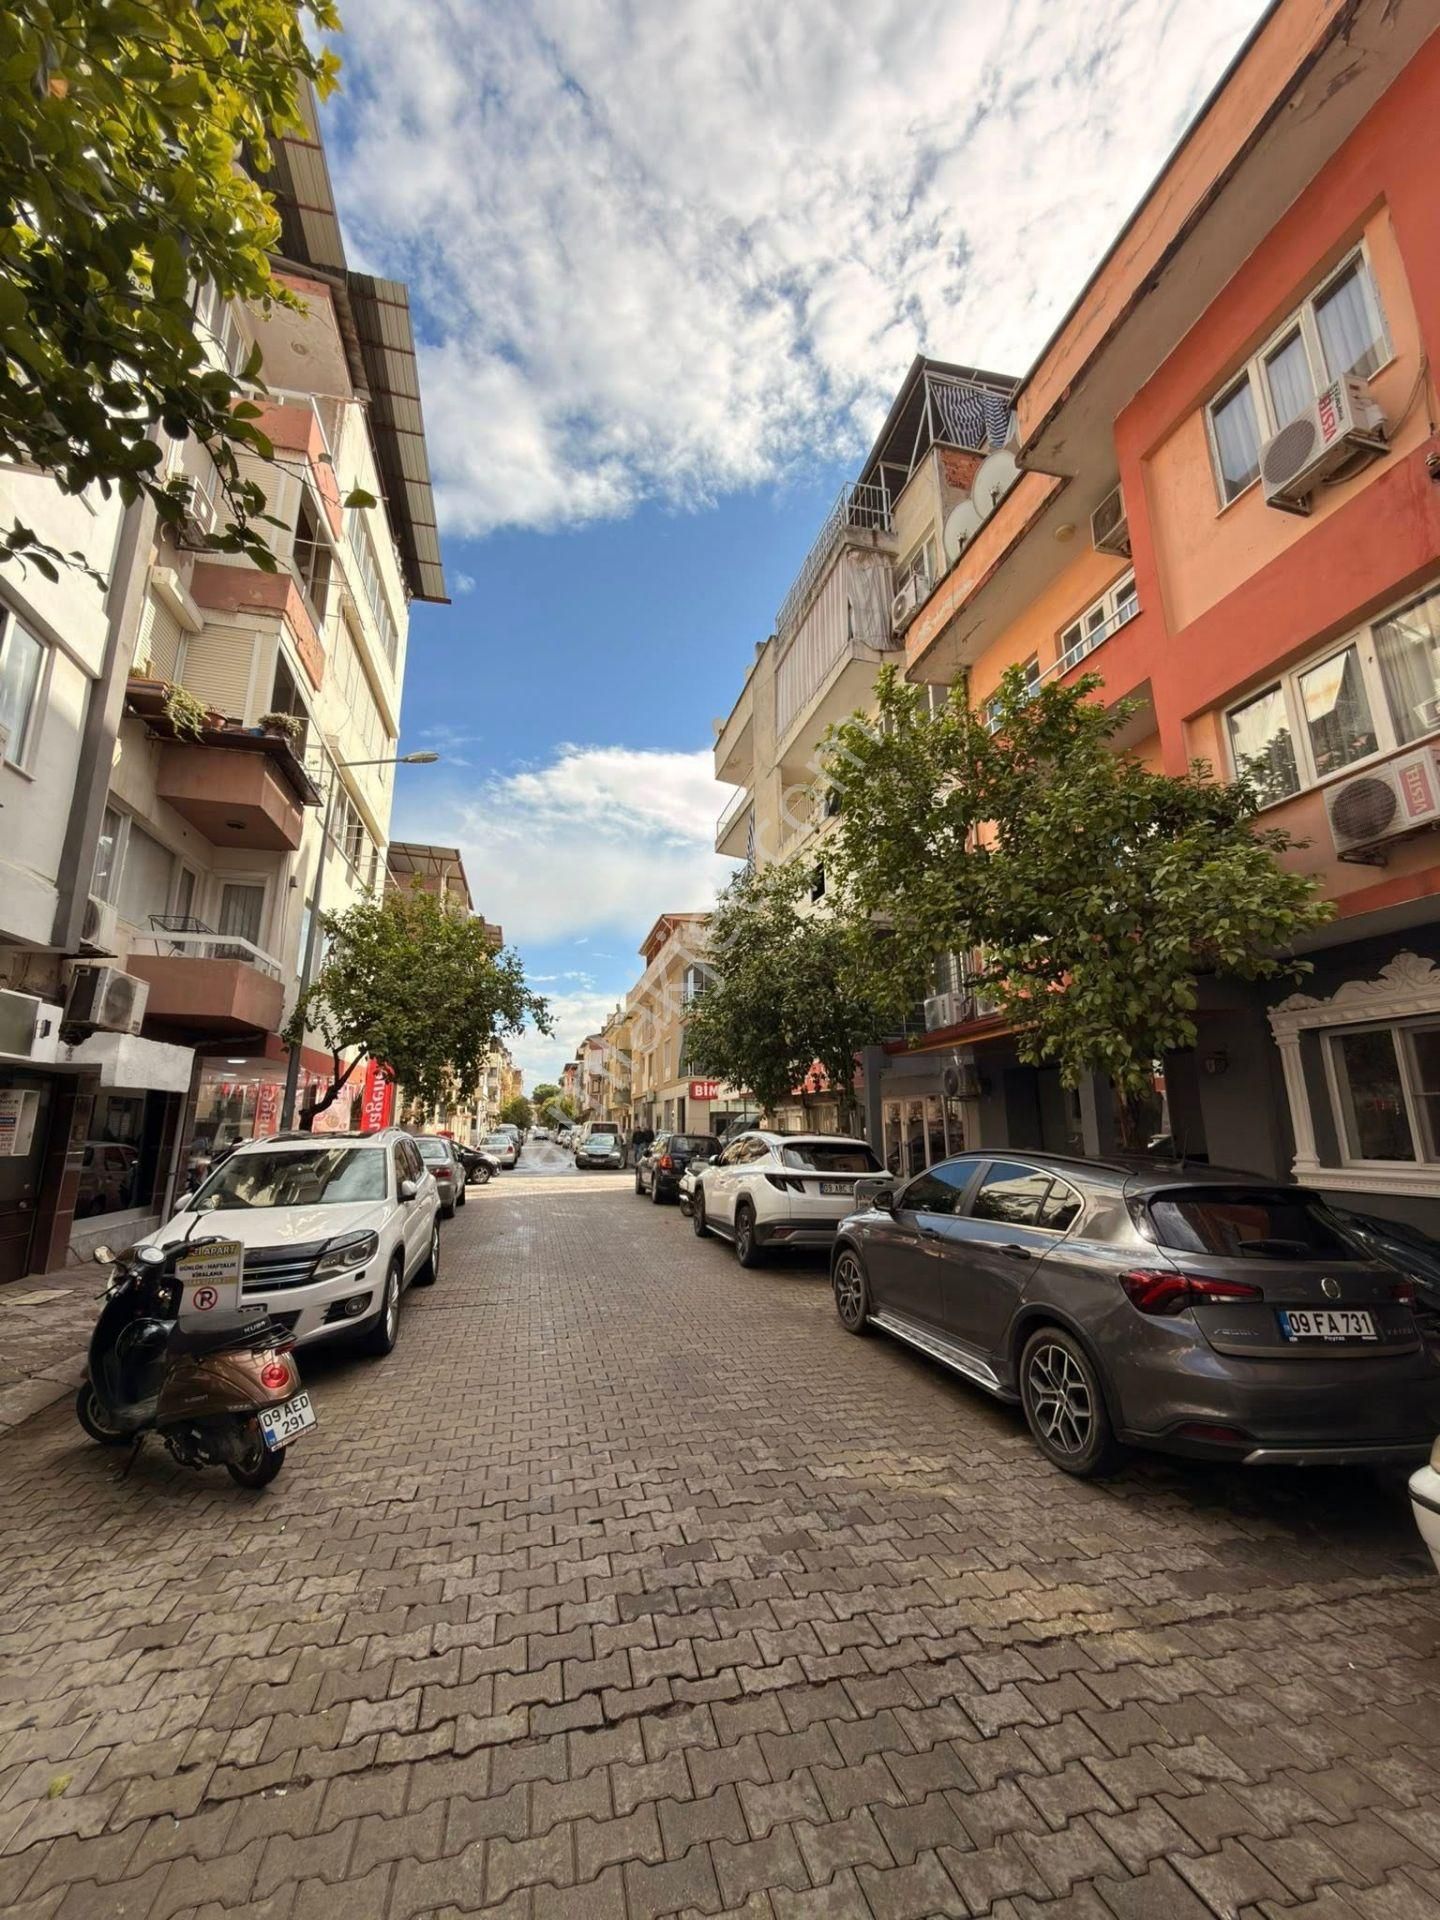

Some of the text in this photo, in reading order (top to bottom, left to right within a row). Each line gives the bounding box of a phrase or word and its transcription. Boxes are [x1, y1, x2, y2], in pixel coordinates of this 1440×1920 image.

[203, 1244, 237, 1256] APART
[1289, 1313, 1371, 1333] 09 FA 731
[263, 1396, 308, 1427] 09 AED
[282, 1414, 305, 1435] 291
